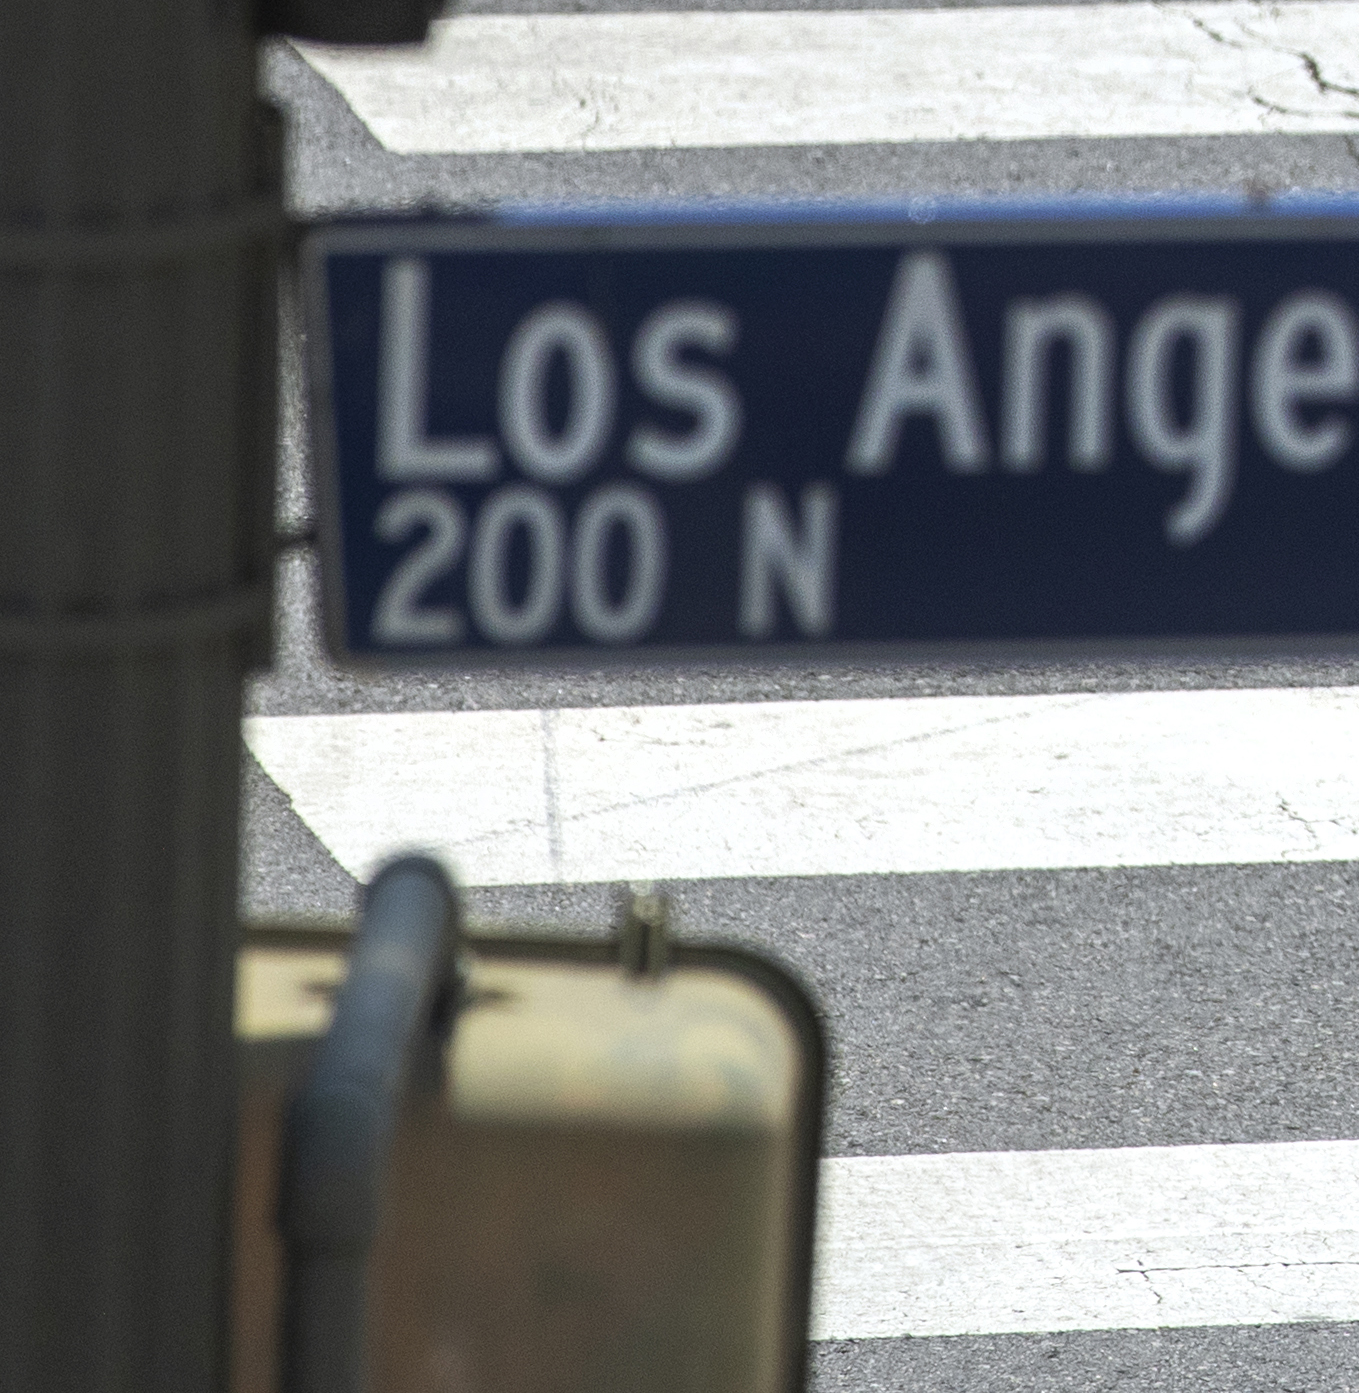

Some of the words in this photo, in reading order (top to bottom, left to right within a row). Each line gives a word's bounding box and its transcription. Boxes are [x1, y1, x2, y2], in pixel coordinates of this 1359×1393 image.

[381, 257, 738, 479] Los
[376, 488, 665, 642] 200
[743, 489, 832, 632] N
